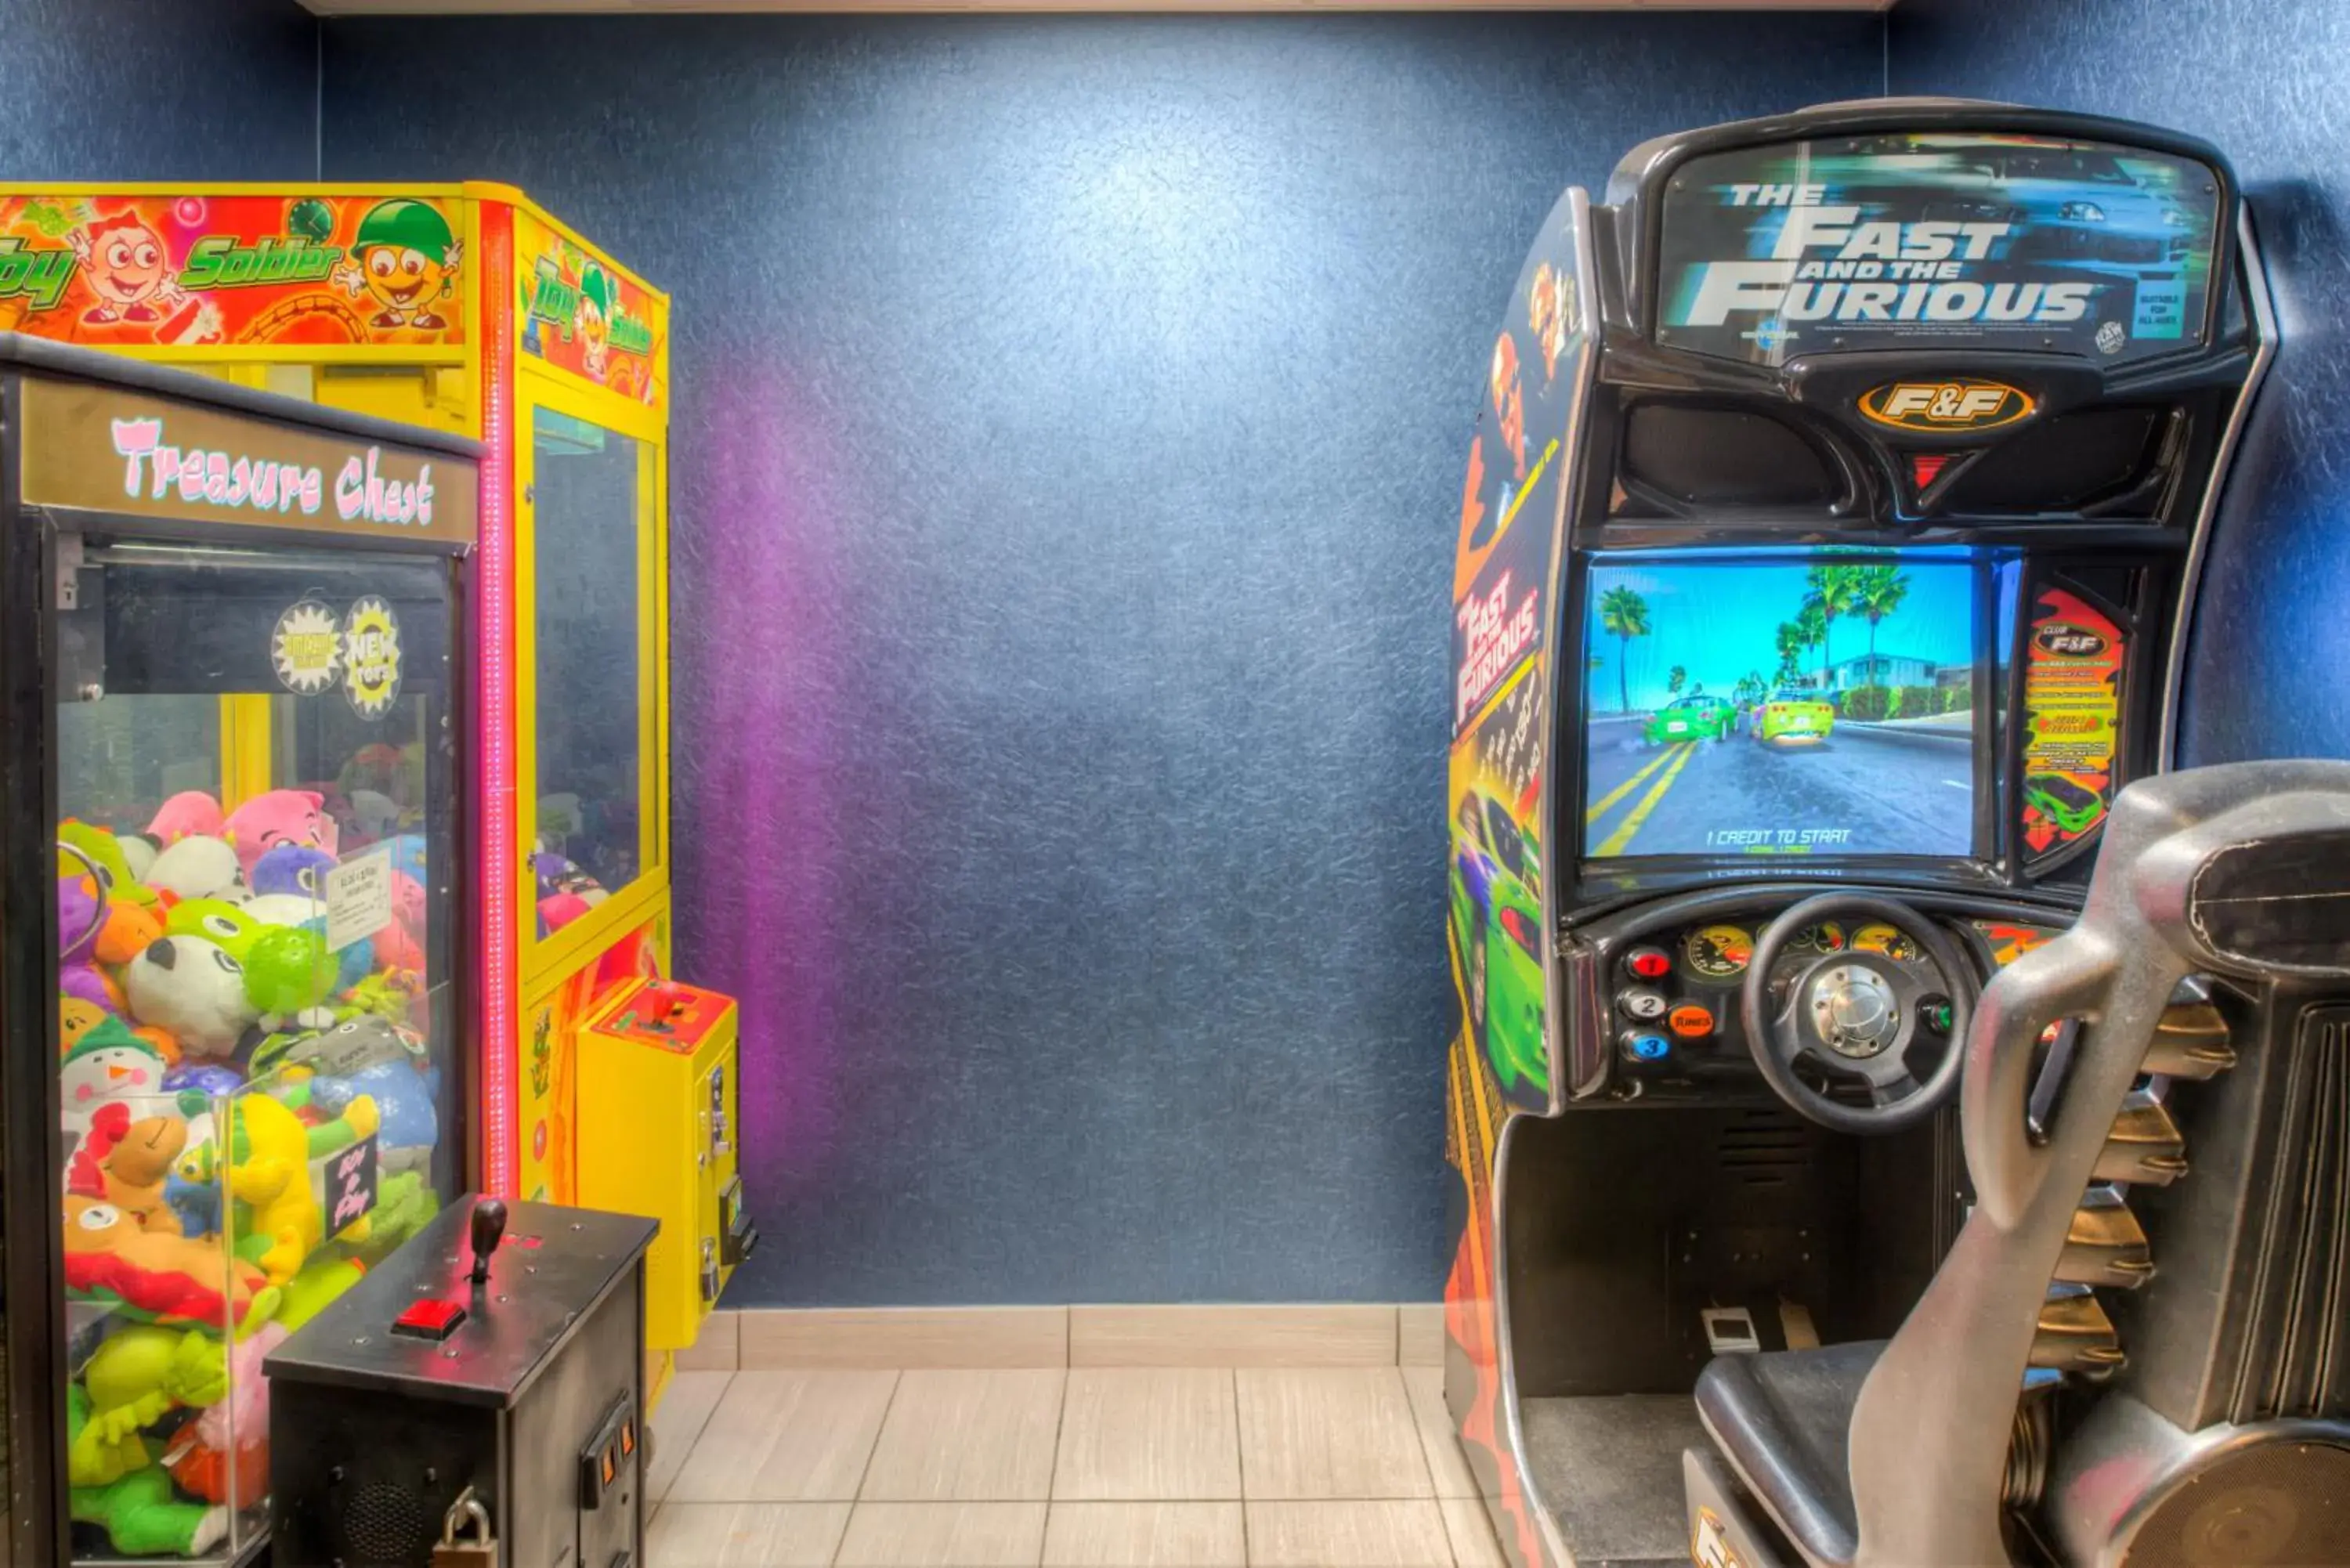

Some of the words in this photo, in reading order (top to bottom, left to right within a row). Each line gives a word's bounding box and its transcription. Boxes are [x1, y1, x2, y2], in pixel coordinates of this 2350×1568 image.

[1731, 184, 1827, 206] THE
[1772, 206, 2011, 259] FAST
[176, 235, 345, 291] Soldier
[1798, 262, 1884, 280] AND
[1889, 262, 1962, 280] THE
[1687, 262, 2095, 326] FURIOUS
[1883, 386, 2007, 419] F&F
[111, 417, 322, 515] Treasure
[334, 445, 435, 526] Chest
[345, 631, 396, 661] NEW
[2052, 636, 2097, 652] F&F
[1716, 830, 1773, 845] CREDIT
[1777, 829, 1797, 844] TO
[1800, 828, 1852, 844] START
[1647, 959, 1657, 973] 1
[1641, 999, 1655, 1013] 2
[1645, 1039, 1659, 1055] 3
